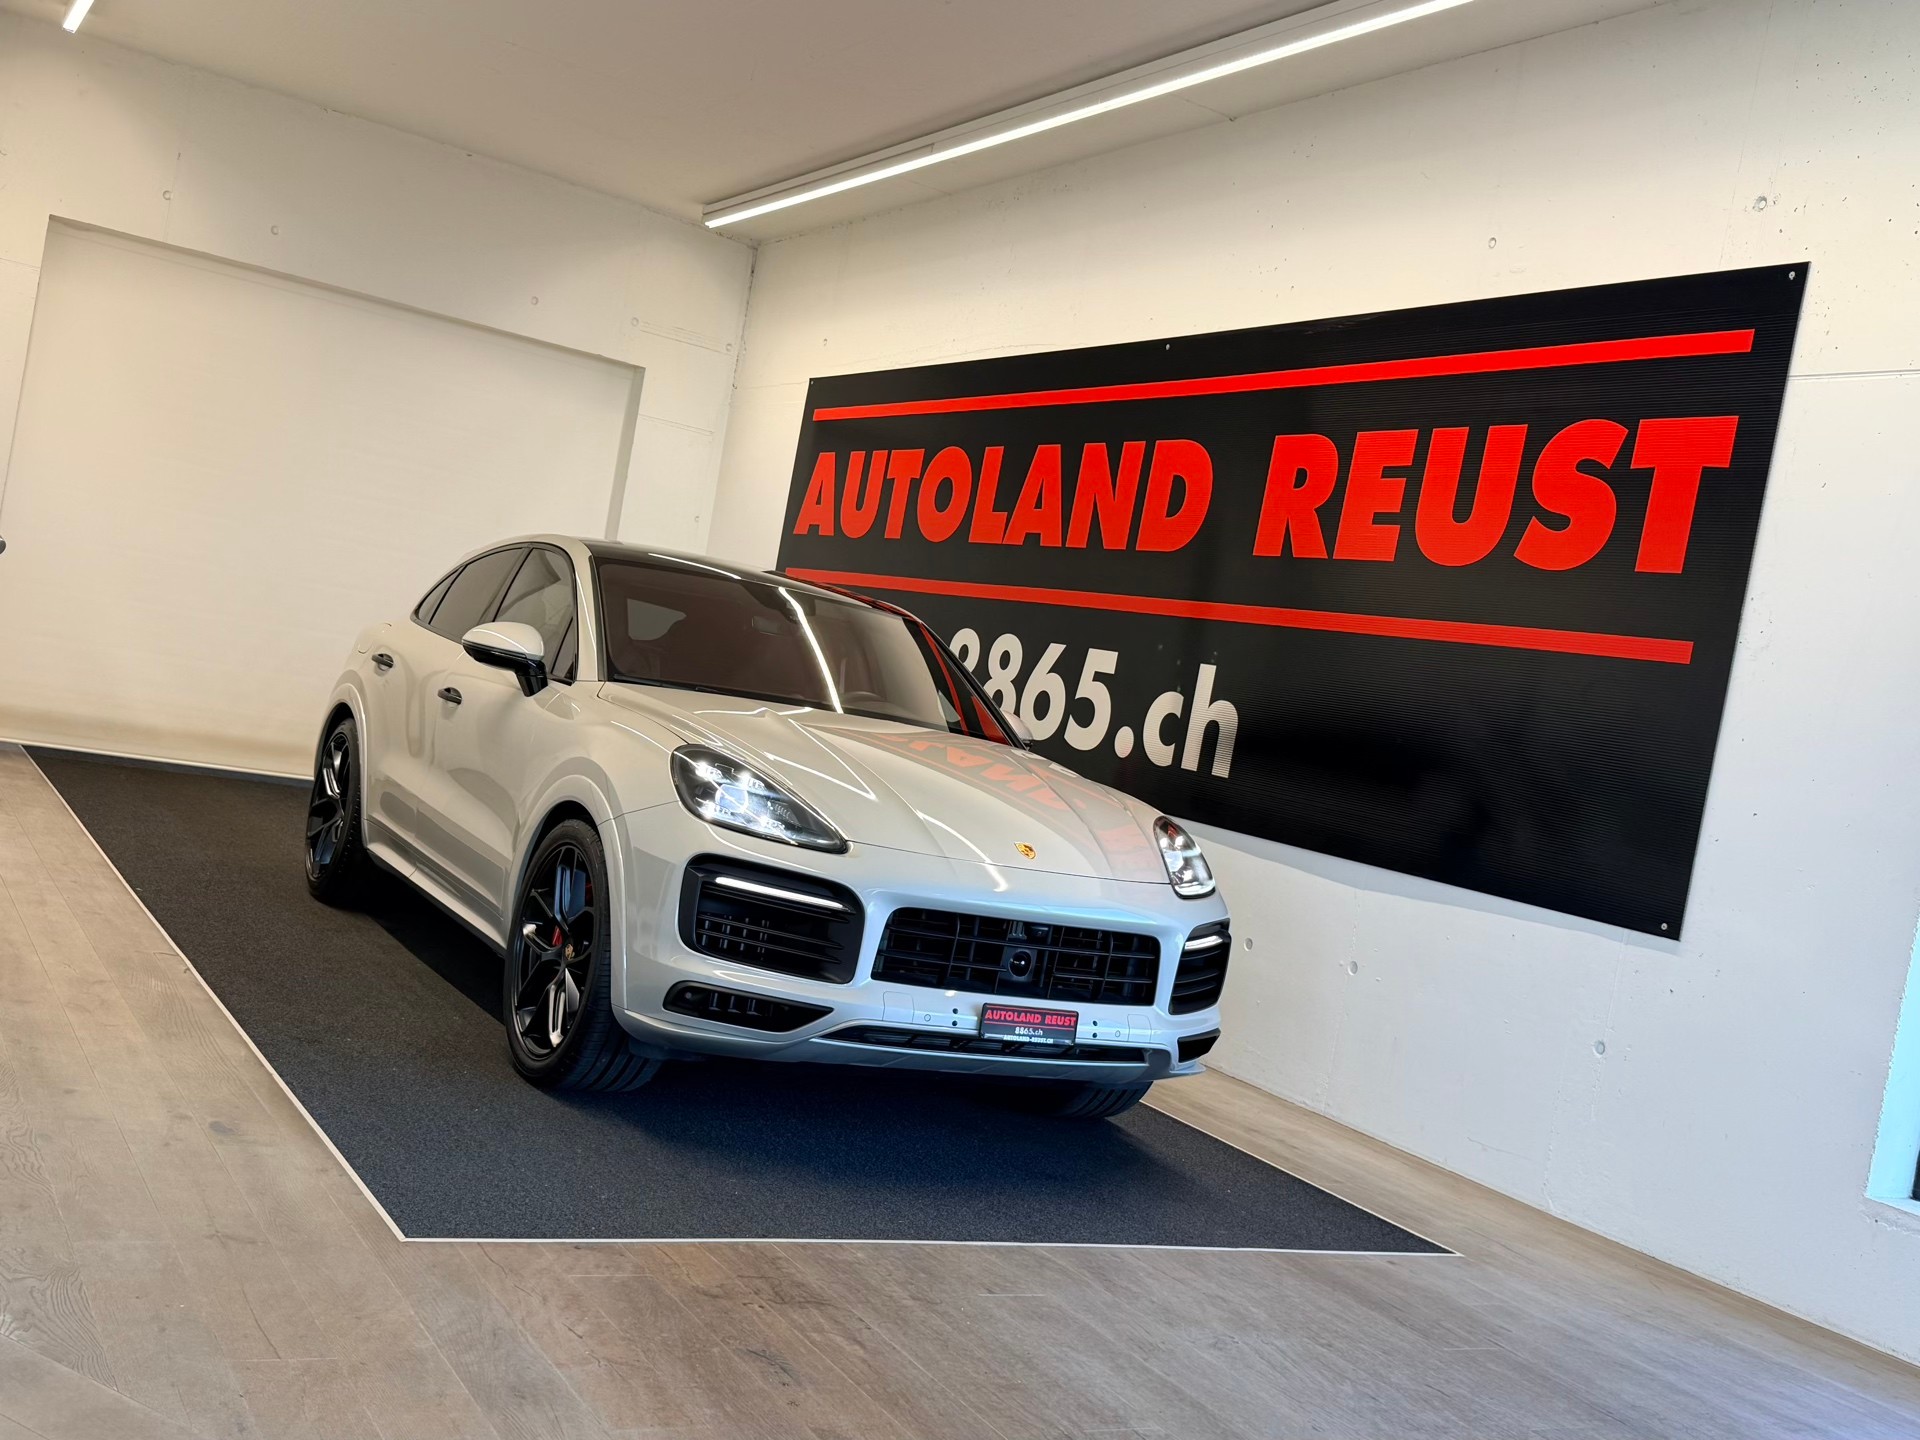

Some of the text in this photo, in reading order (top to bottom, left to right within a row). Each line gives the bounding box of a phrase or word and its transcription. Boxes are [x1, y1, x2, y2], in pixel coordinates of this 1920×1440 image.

[793, 416, 1739, 573] AUTOLAND REUST
[984, 1009, 1077, 1026] AUTOLAND REUST
[1014, 1026, 1043, 1036] 8865.ch
